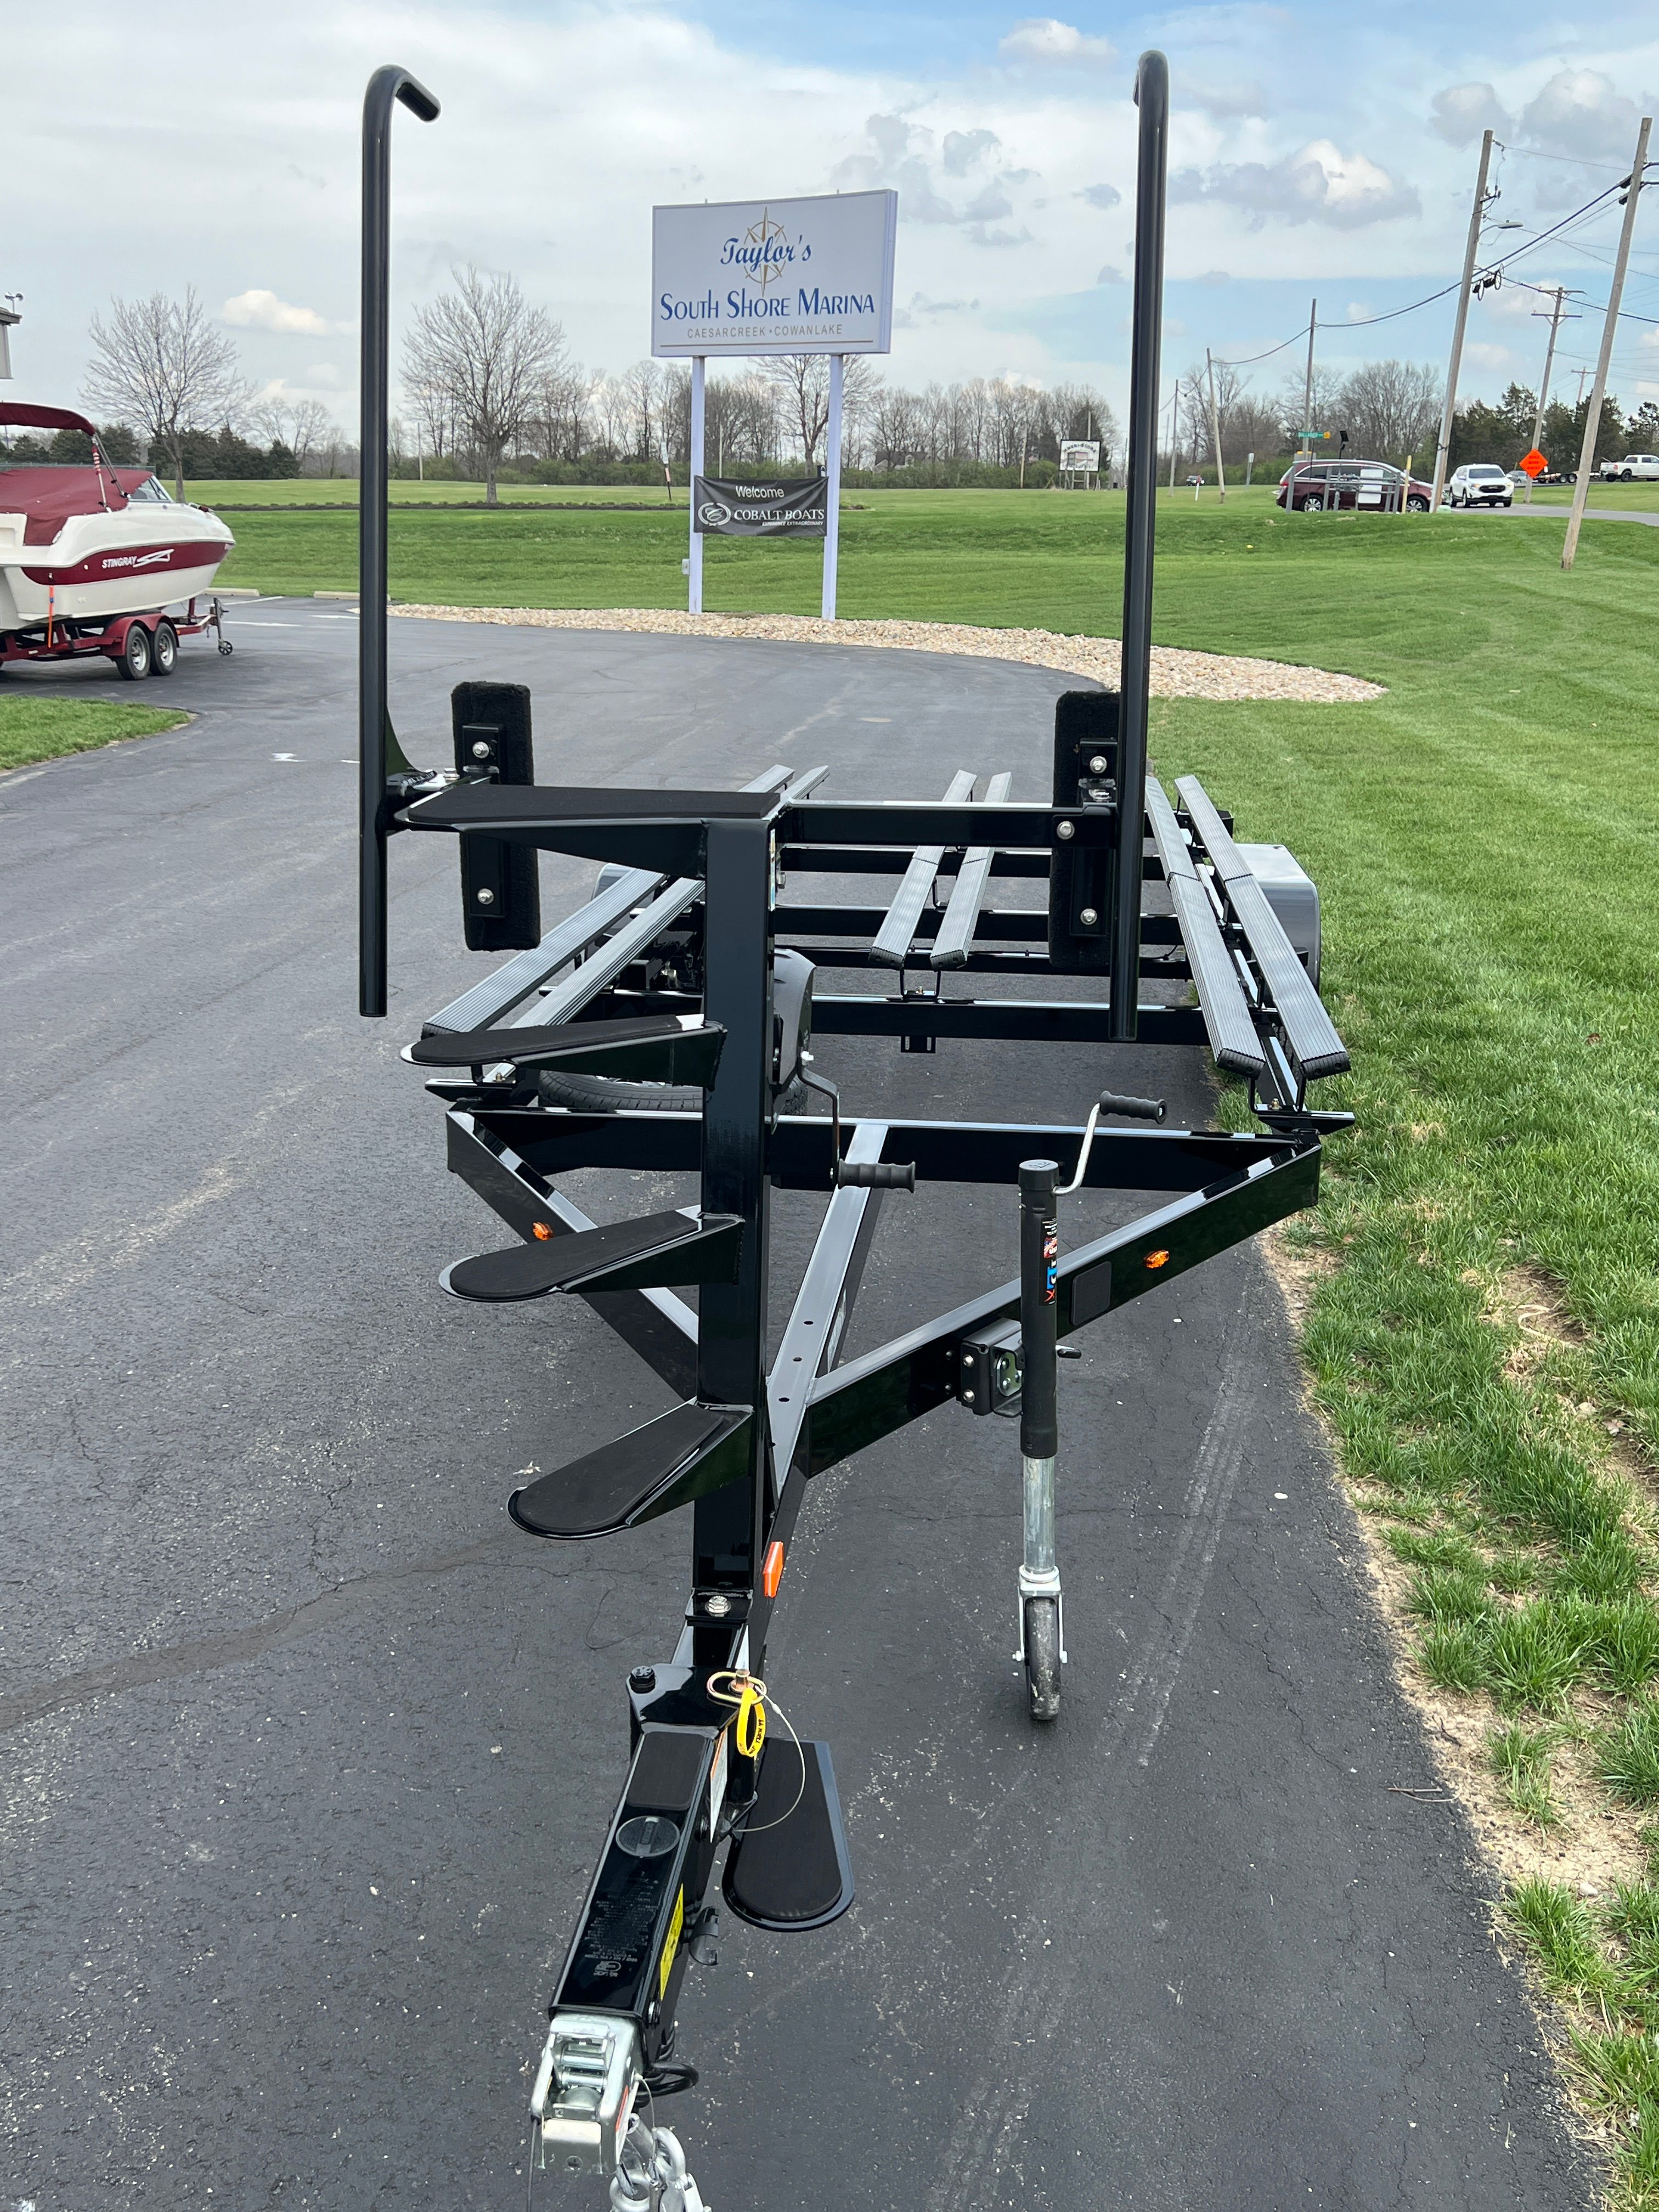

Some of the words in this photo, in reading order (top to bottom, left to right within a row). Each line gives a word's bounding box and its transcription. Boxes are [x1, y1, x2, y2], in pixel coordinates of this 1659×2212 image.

[720, 234, 812, 273] Taylor's
[661, 289, 719, 320] SOUTH
[727, 288, 791, 318] SHORE
[798, 287, 874, 316] MARINA
[735, 486, 785, 498] Welcome
[733, 510, 782, 521] COBALT
[784, 509, 825, 520] BOATS
[101, 556, 137, 569] STINGRAY
